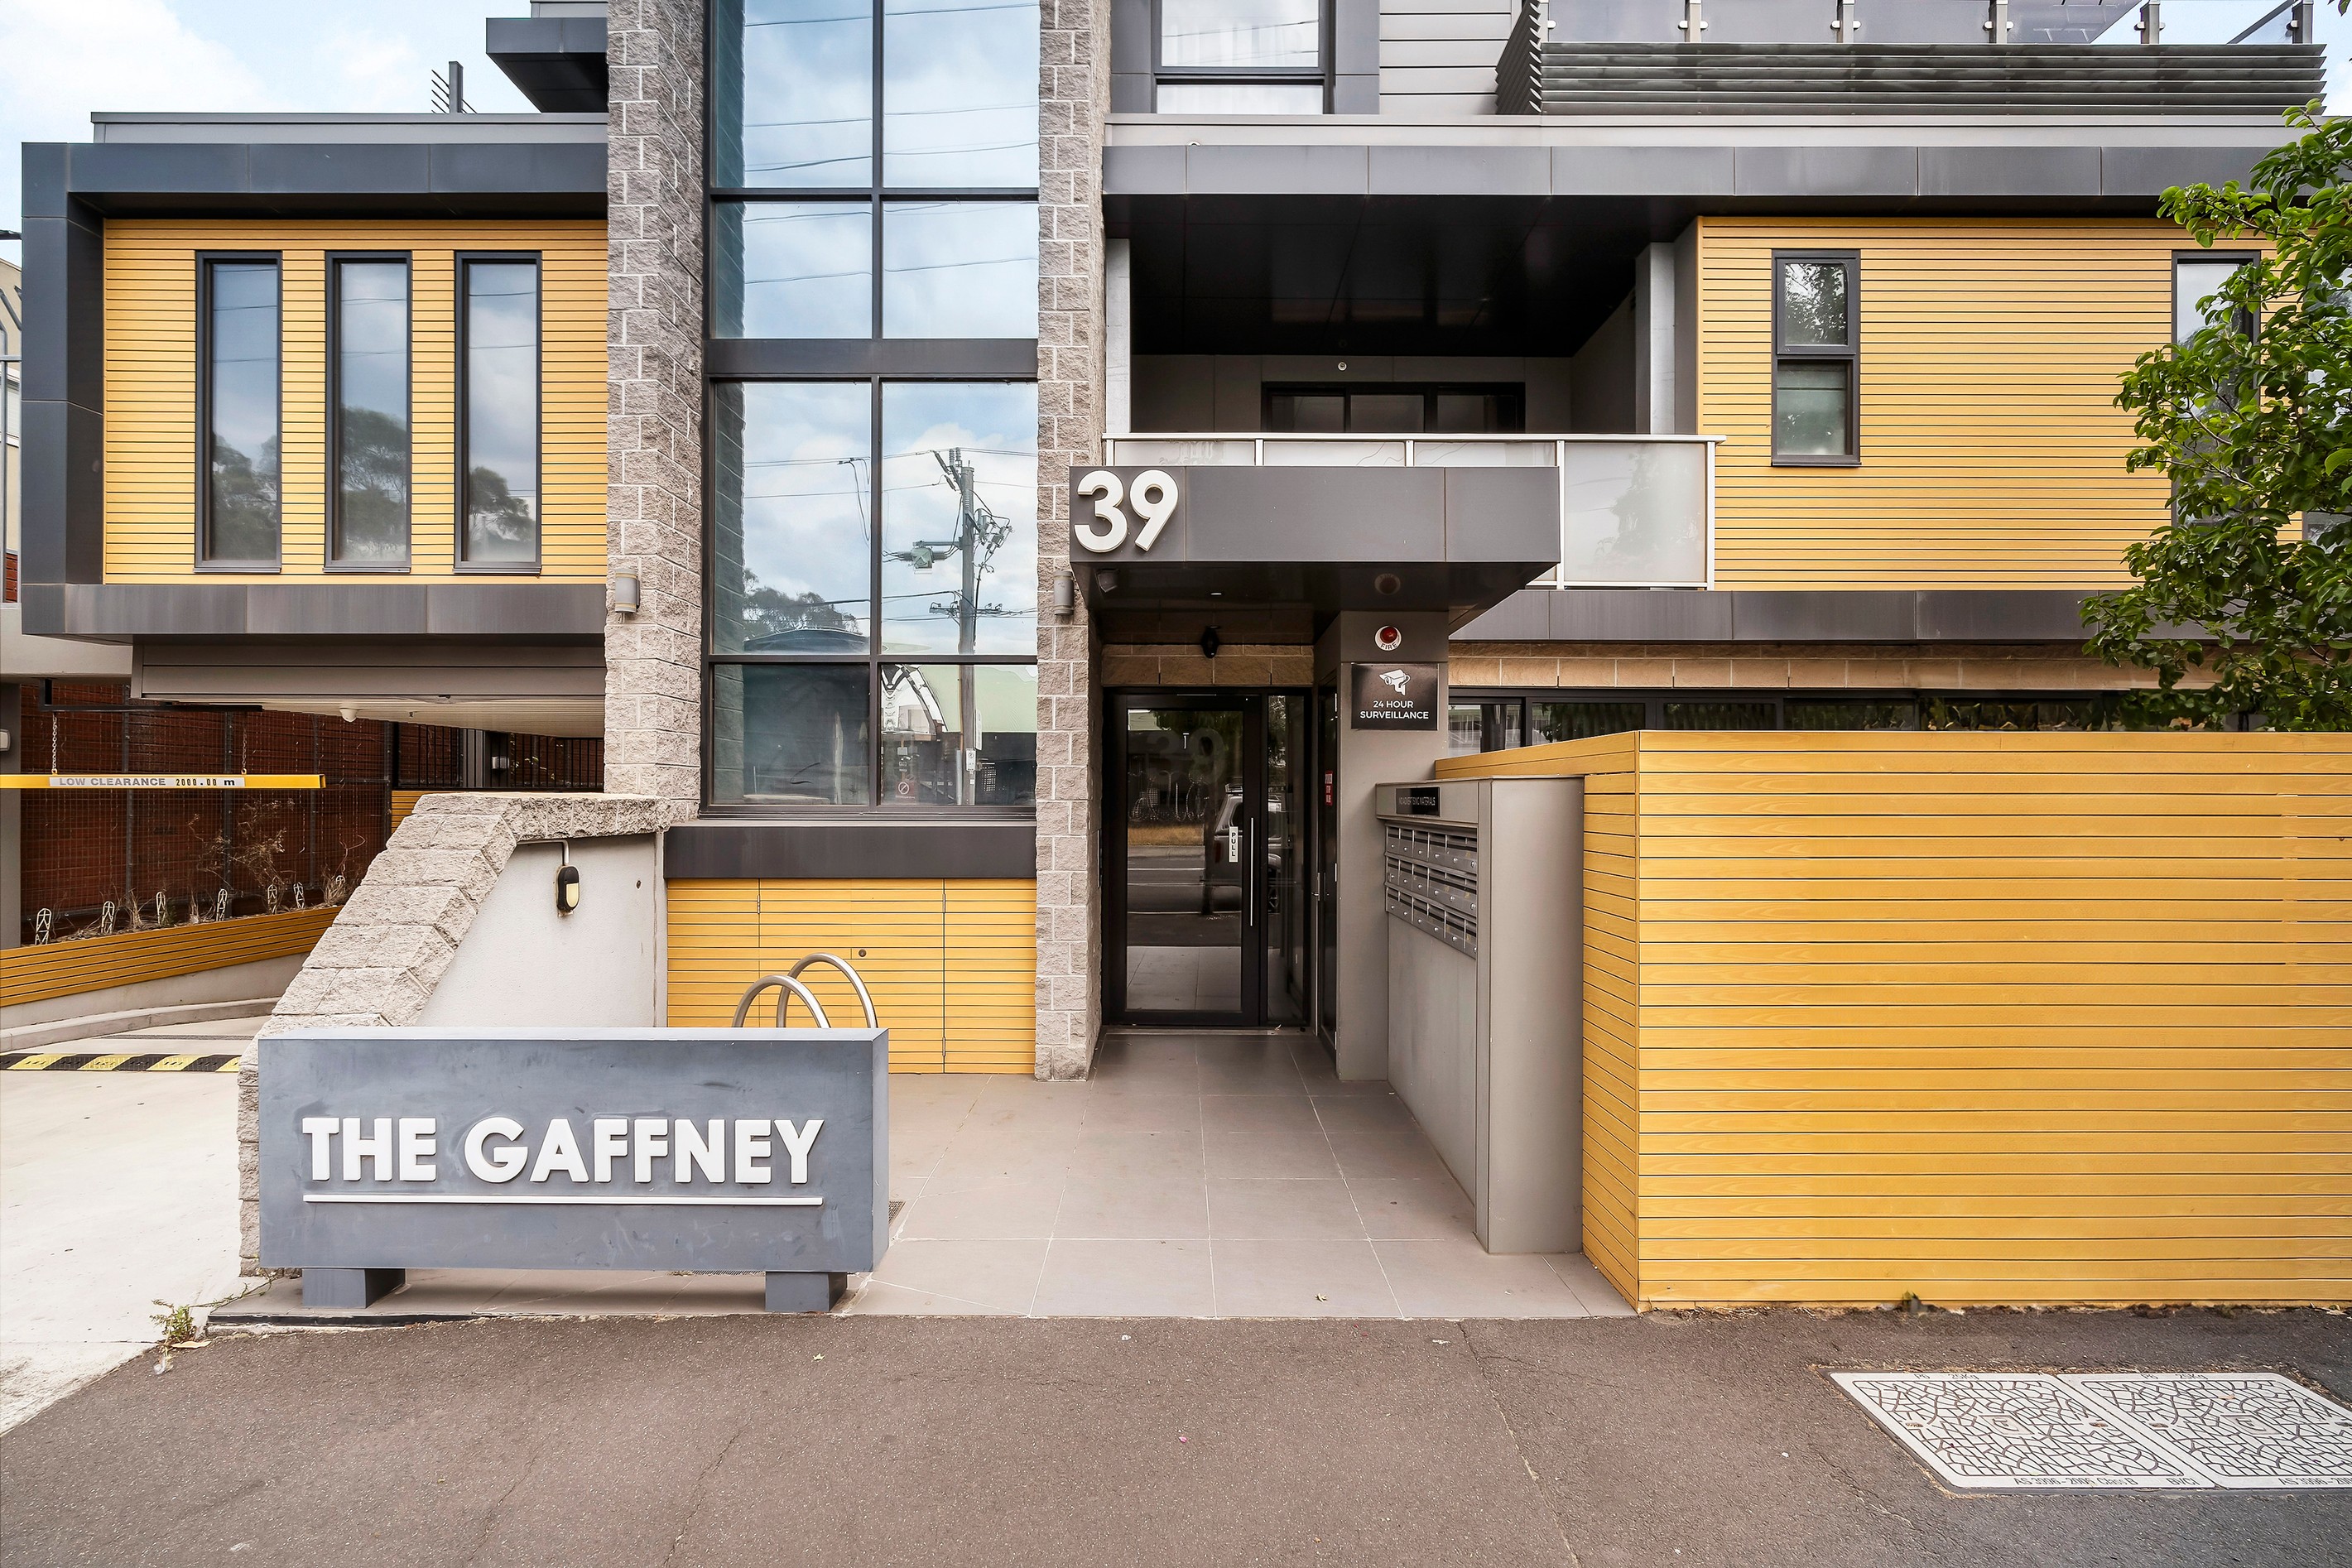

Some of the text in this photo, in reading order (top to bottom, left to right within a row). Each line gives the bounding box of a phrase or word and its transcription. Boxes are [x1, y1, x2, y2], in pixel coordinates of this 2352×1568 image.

[1074, 469, 1179, 553] 39
[1380, 642, 1397, 650] FIRE
[1373, 700, 1414, 709] 24 HOUR
[1359, 710, 1429, 719] SURVEILLANCE
[59, 777, 85, 786] LOW
[90, 777, 166, 786] CLEARANCE
[176, 778, 217, 786] 2000.00
[302, 1117, 824, 1184] THE GAFFNEY
[2013, 1477, 2033, 1485] AS
[2096, 1477, 2128, 1485] Class
